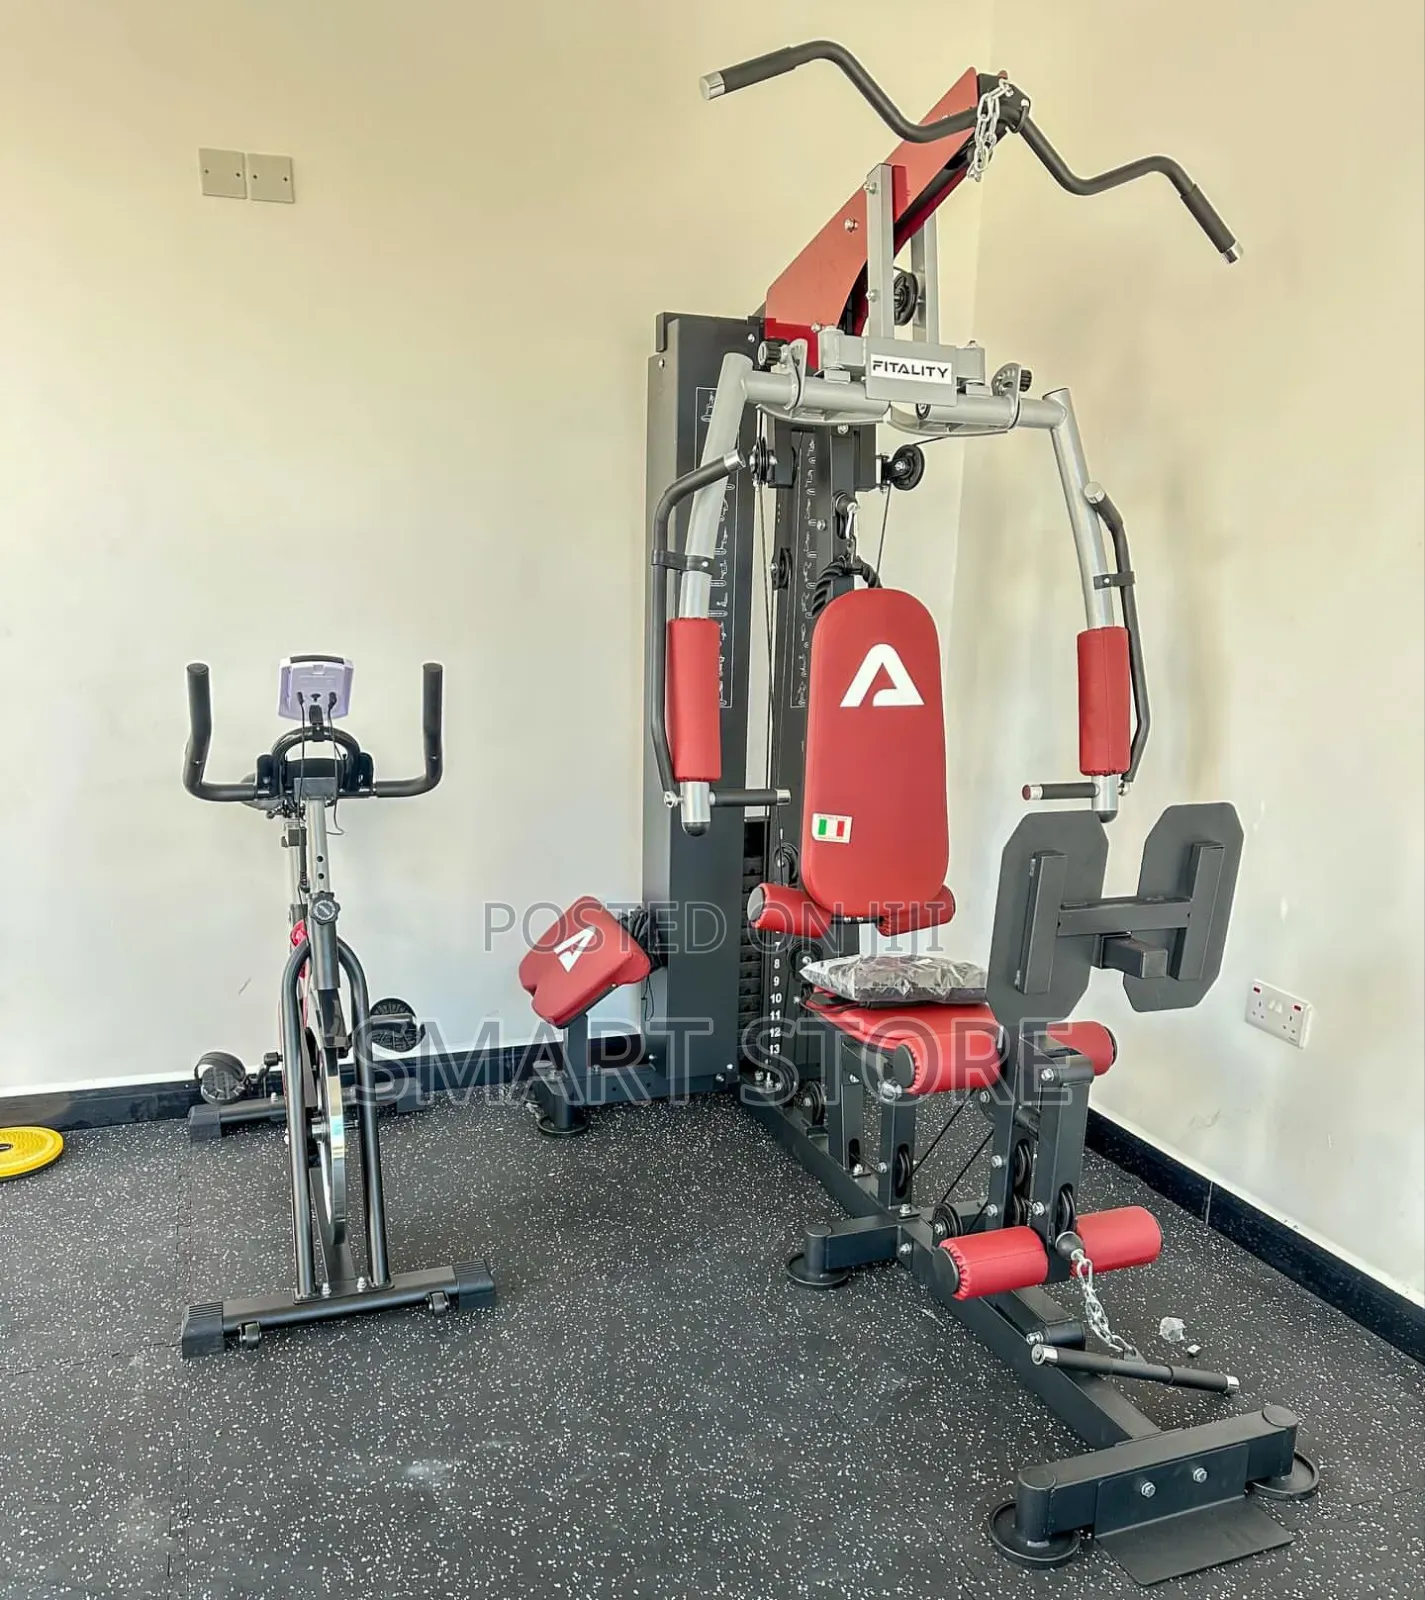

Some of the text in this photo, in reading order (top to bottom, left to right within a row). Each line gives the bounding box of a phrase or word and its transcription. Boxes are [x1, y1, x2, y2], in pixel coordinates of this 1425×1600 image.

[873, 360, 948, 378] FITALITY
[774, 959, 780, 969] 8
[773, 976, 780, 987] 9
[770, 993, 782, 1003] 10
[770, 1010, 781, 1020] 11
[769, 1028, 781, 1038] 12
[769, 1045, 780, 1055] 13
